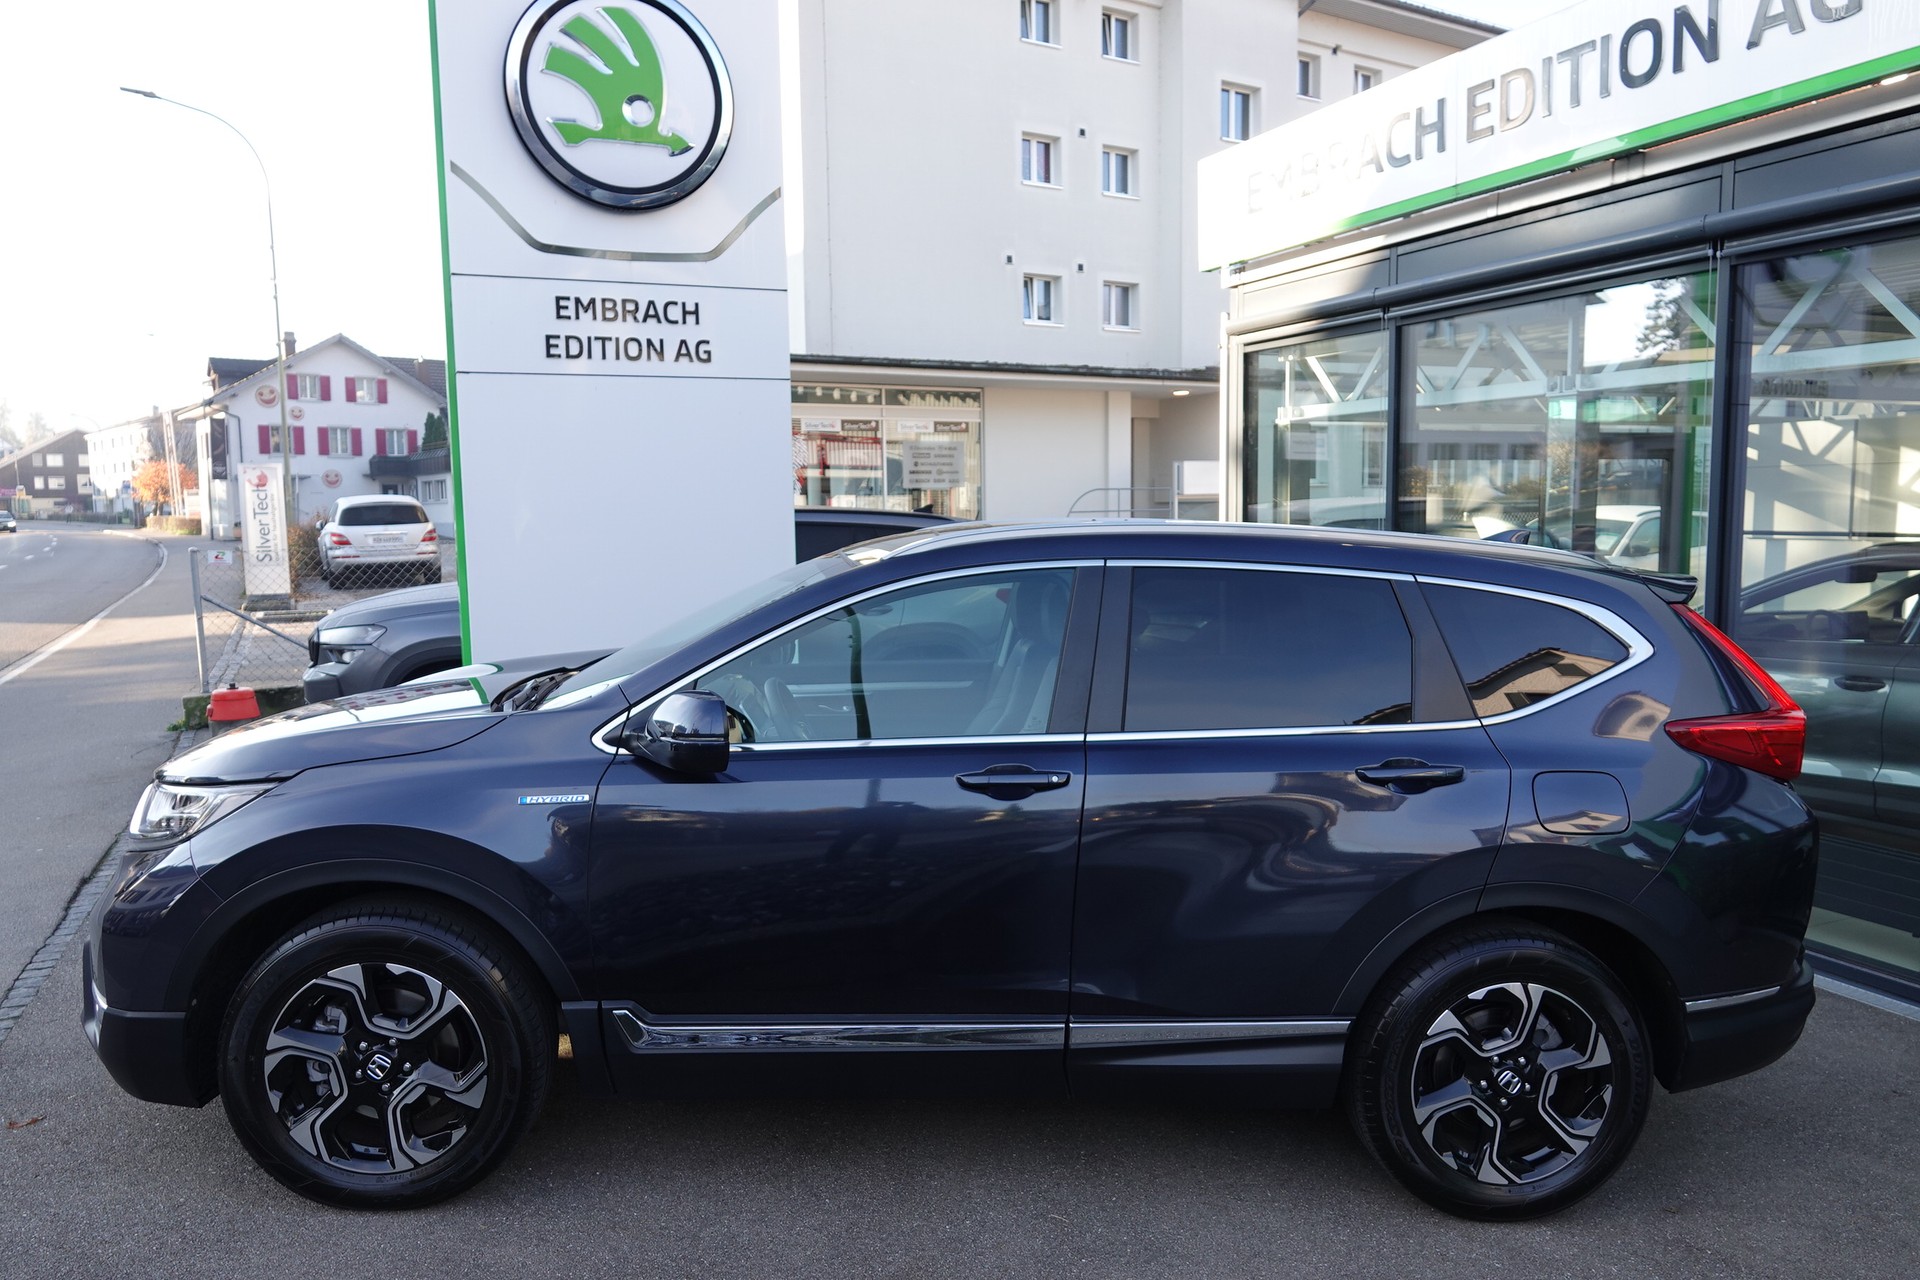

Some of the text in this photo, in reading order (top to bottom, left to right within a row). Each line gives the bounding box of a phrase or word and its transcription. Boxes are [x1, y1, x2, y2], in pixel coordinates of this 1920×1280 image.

[1247, 98, 1446, 214] EMBRACH
[1464, 0, 1719, 143] EDITION
[554, 295, 700, 325] EMBRACH
[545, 333, 713, 363] EDITION AG
[529, 795, 585, 804] HYBRID
